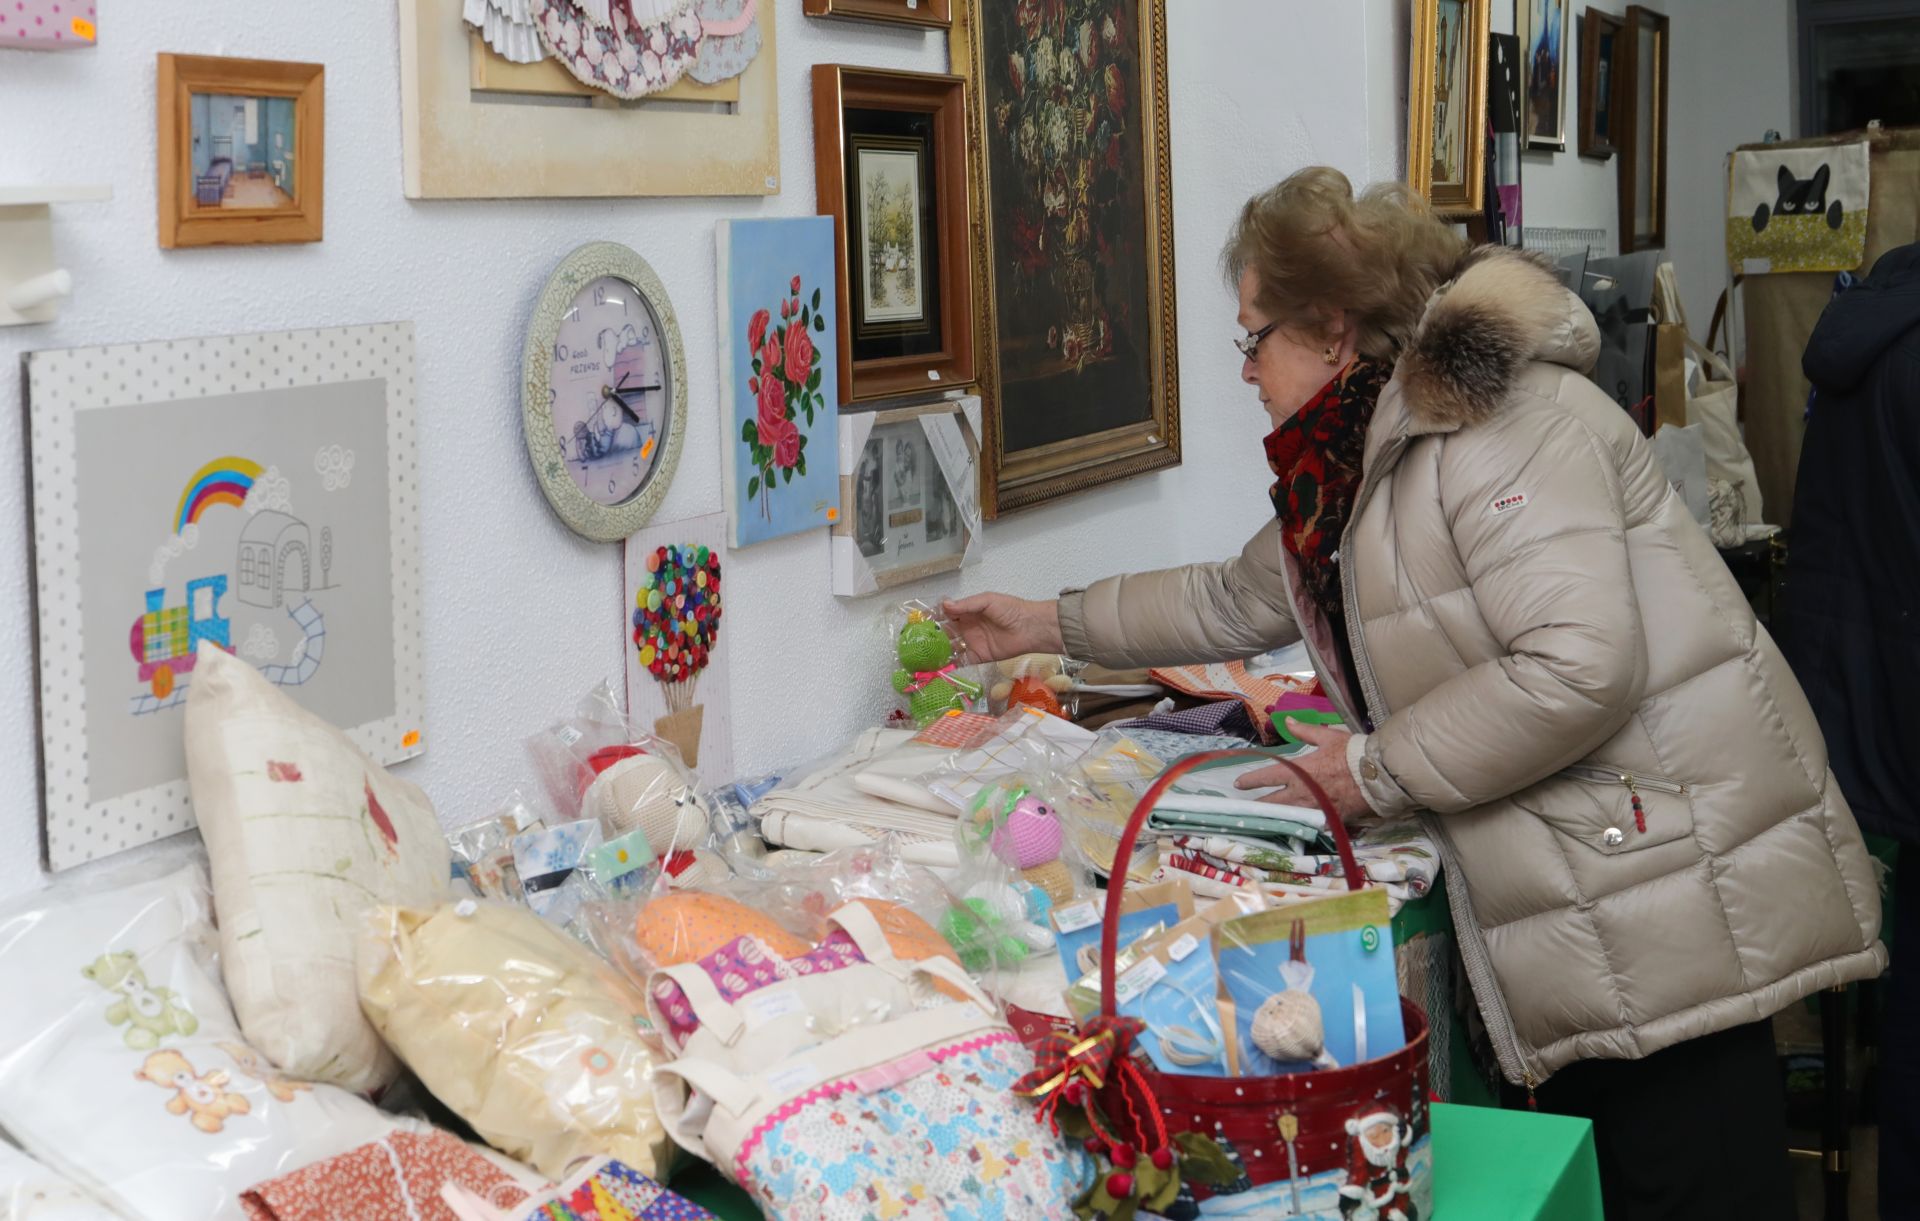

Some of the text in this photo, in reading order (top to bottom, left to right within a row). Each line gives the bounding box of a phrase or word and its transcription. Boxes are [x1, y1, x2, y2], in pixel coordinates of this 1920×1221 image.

[593, 286, 606, 307] 12
[553, 343, 568, 362] 10
[570, 362, 601, 375] FRIENDS
[559, 436, 567, 458] 8
[581, 465, 589, 487] 7
[632, 456, 639, 477] 5
[608, 472, 616, 494] 6
